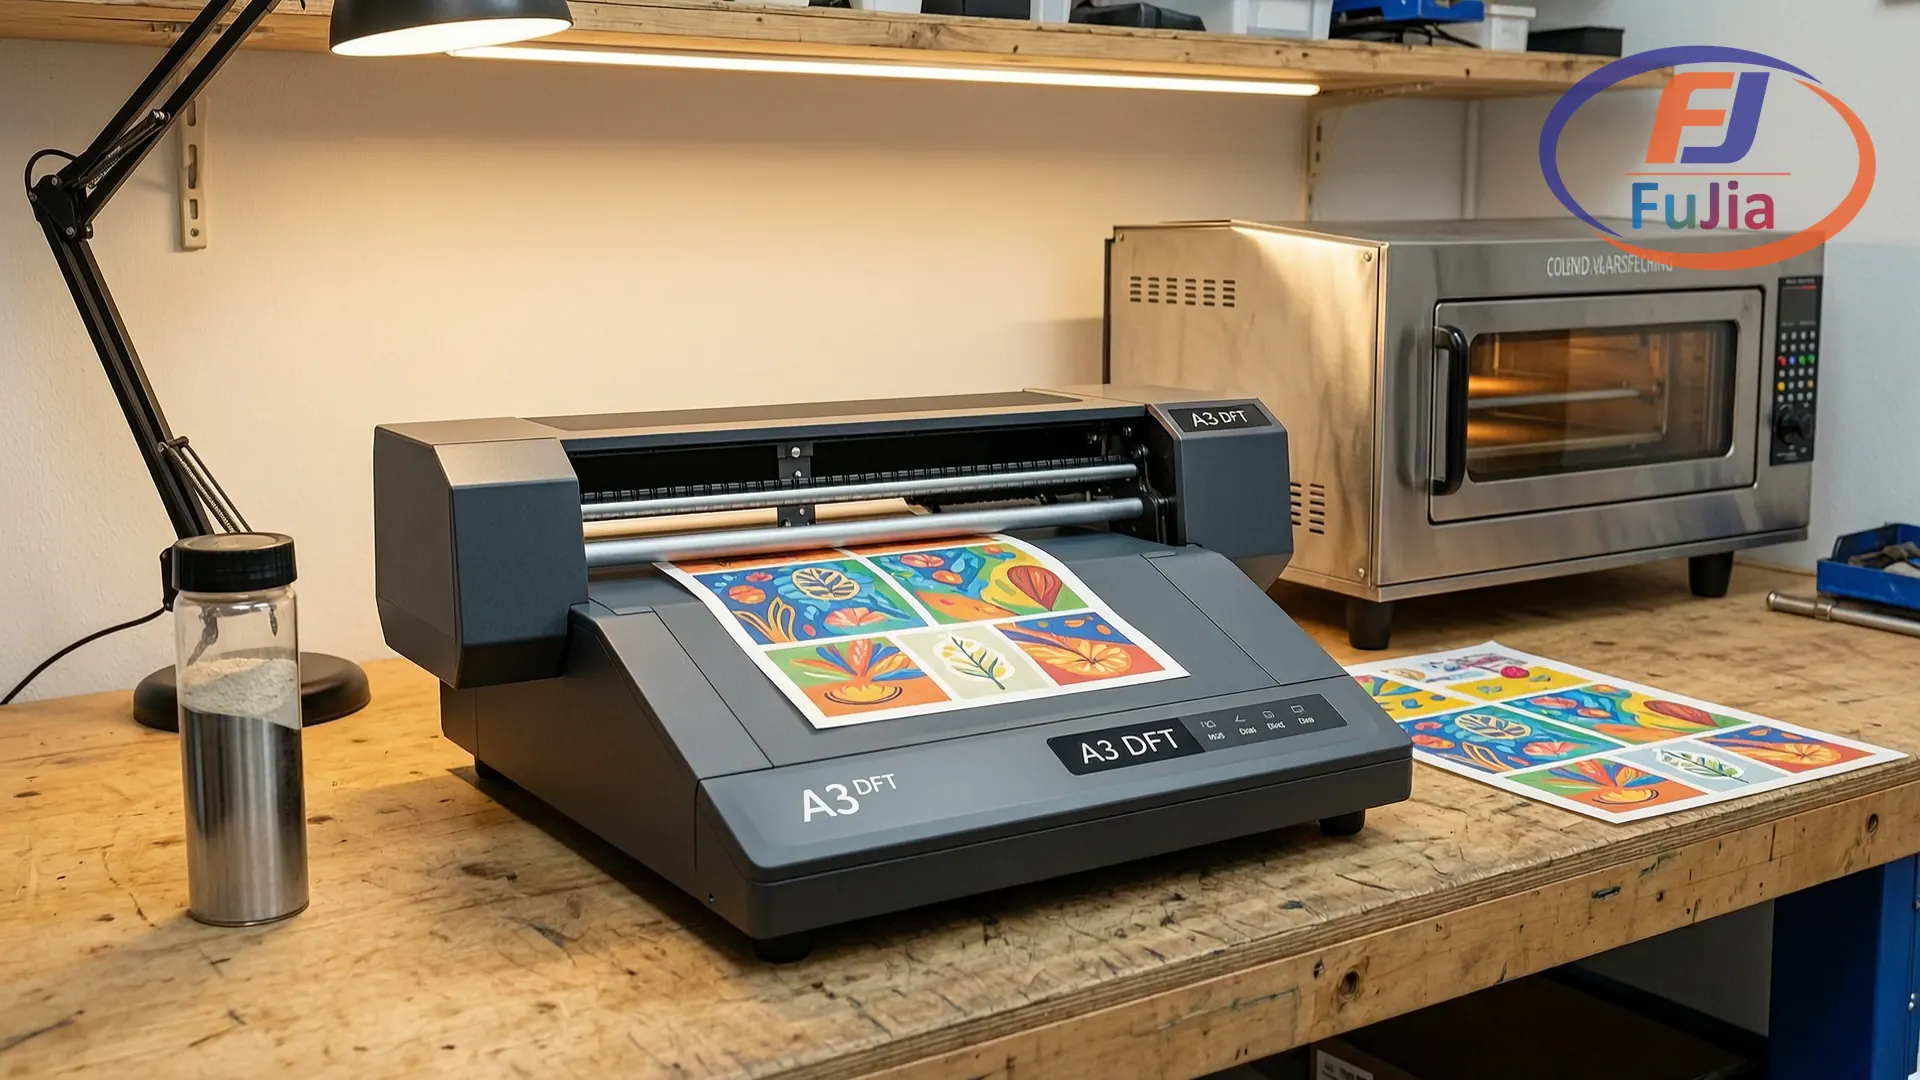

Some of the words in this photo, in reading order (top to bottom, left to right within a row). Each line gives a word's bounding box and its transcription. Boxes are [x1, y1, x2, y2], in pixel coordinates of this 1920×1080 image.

[1191, 412, 1219, 428] A3
[1219, 410, 1248, 424] DFT
[1080, 740, 1120, 765] A3
[1121, 728, 1179, 756] DFT
[803, 783, 860, 823] A3
[852, 773, 897, 796] DFT
